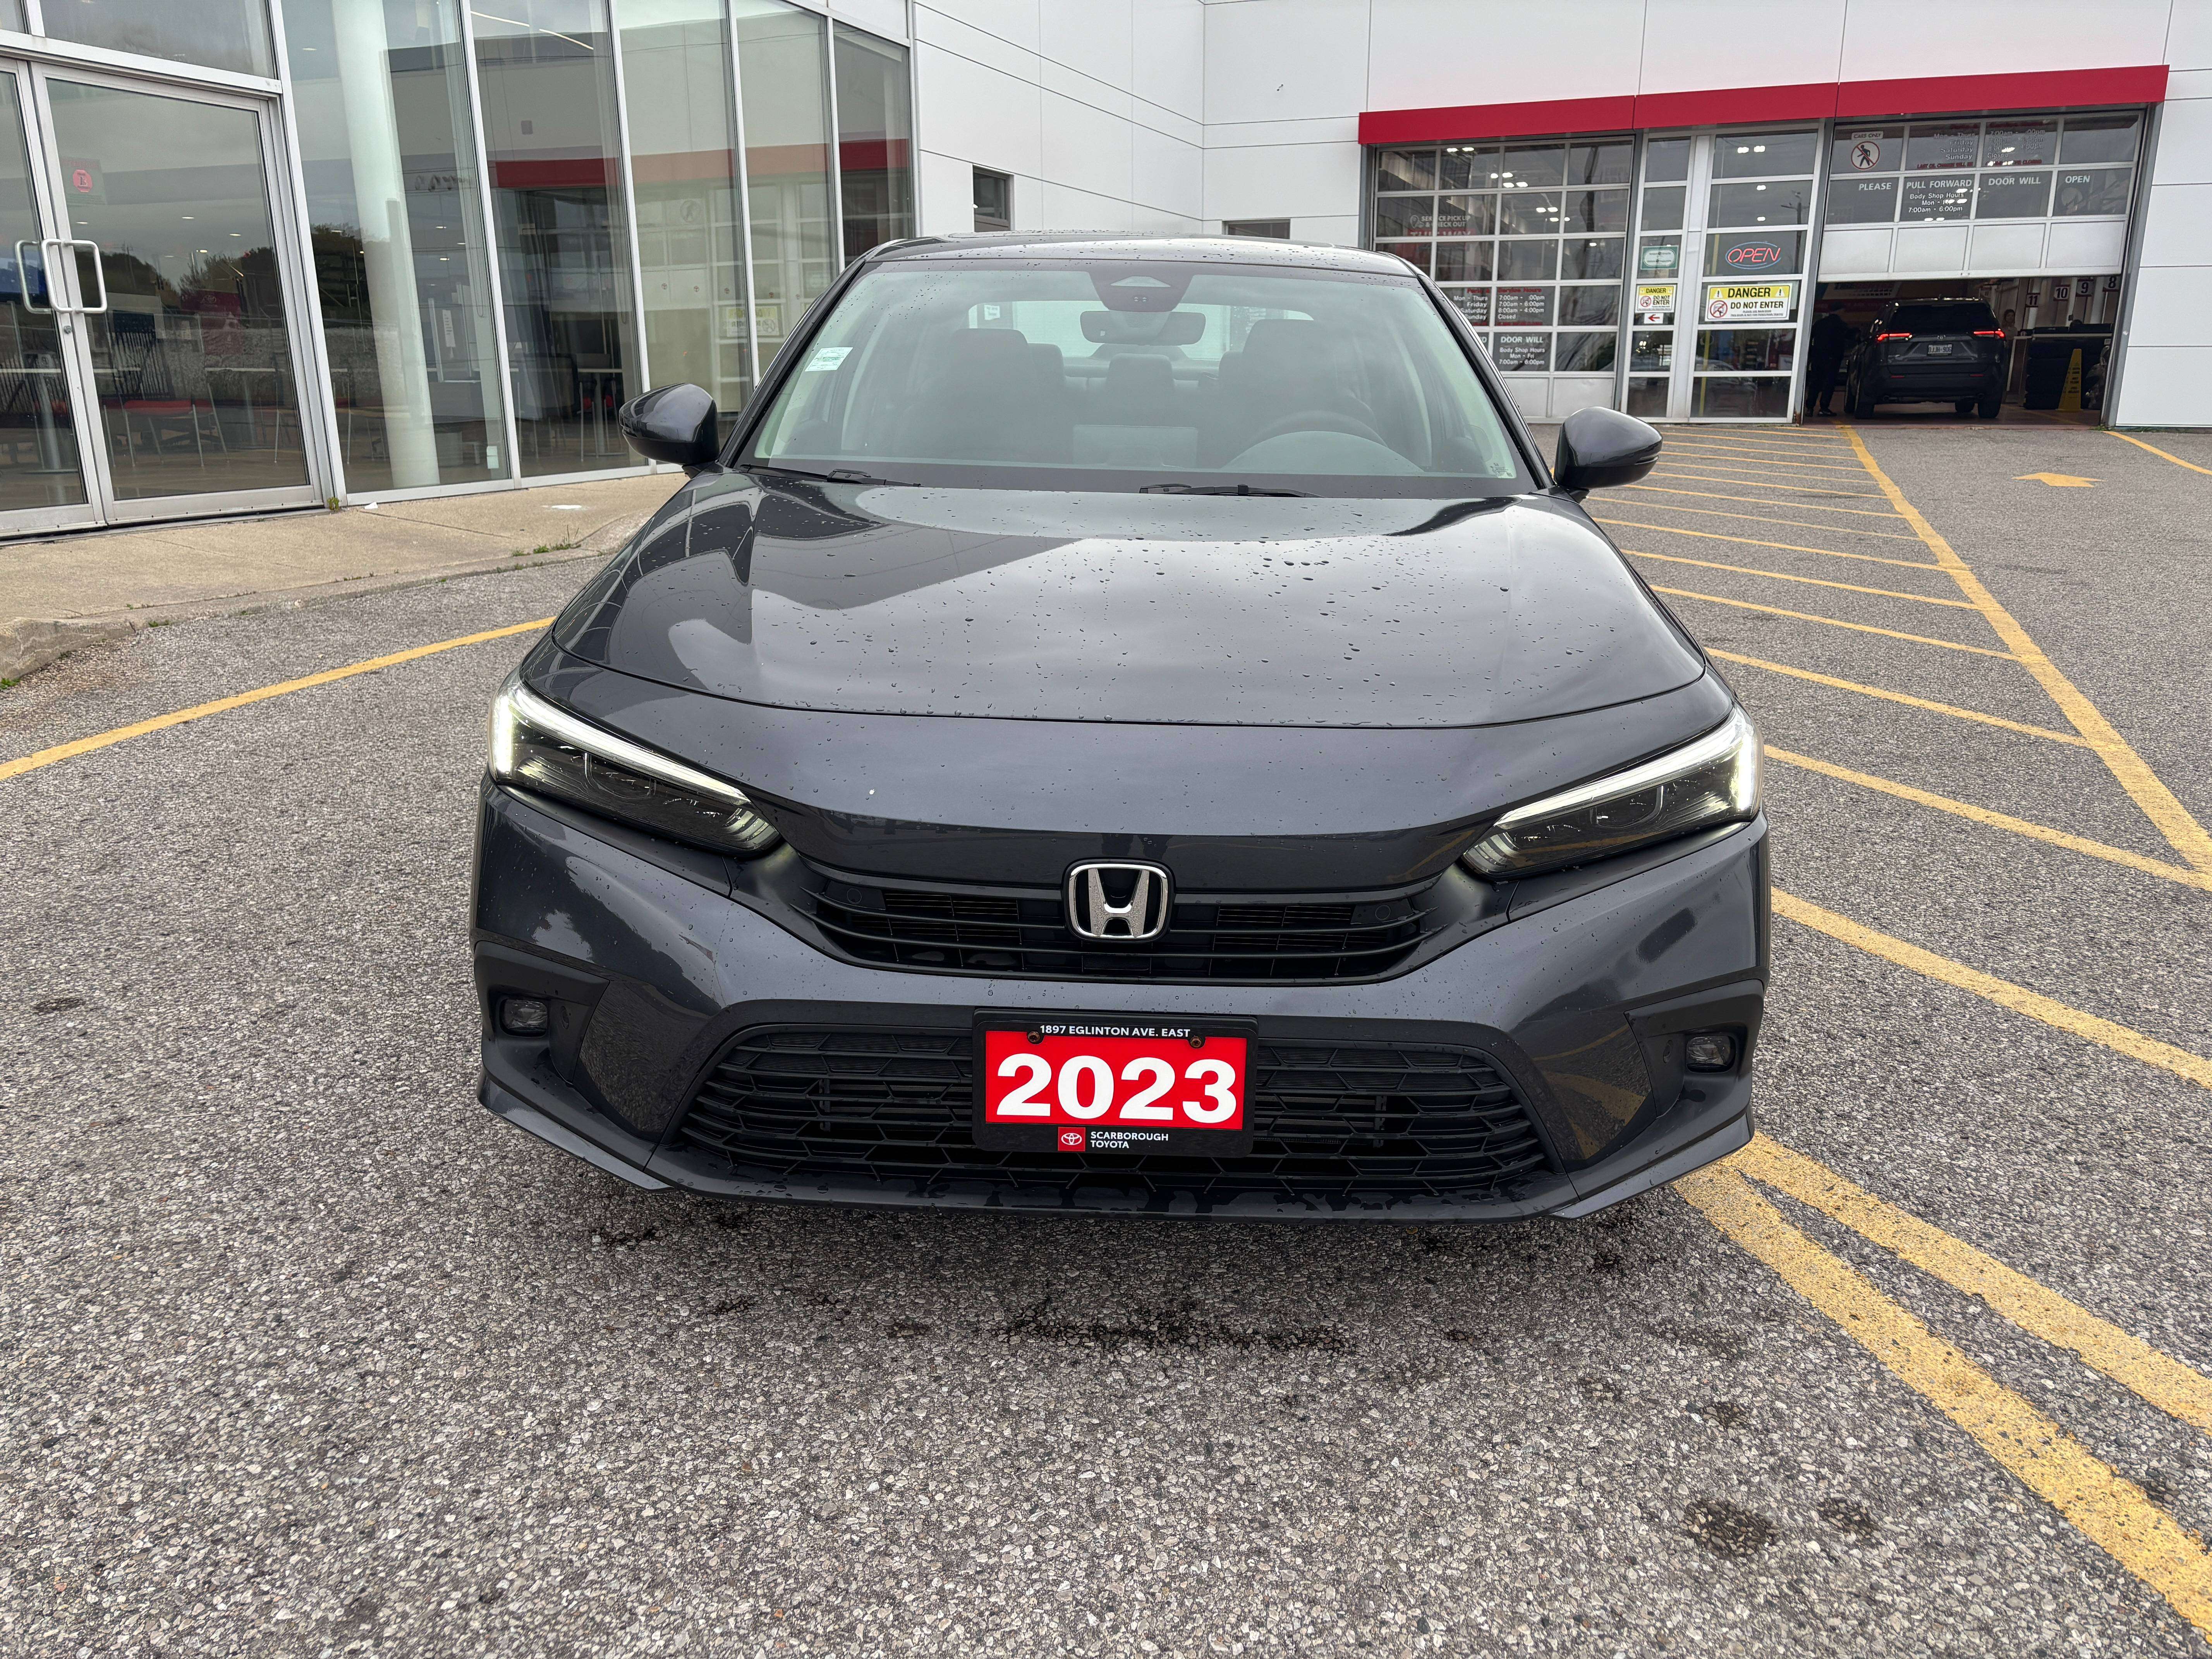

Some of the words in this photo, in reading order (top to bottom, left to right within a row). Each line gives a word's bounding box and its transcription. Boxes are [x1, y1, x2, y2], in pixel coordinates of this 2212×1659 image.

[1906, 181, 1926, 189] PULL
[1930, 180, 1972, 188] FORWARD
[2065, 175, 2090, 183] OPEN
[1728, 248, 1781, 263] OPEN
[2081, 282, 2089, 294] 9
[2109, 276, 2116, 288] 8
[1728, 287, 1771, 298] DANGER
[2056, 287, 2068, 299] 10
[2029, 295, 2038, 305] 11
[1039, 1025, 1066, 1034] 1897
[1069, 1026, 1129, 1036] EGLINTON
[1132, 1027, 1158, 1037] AVE.
[1161, 1029, 1190, 1037] EAST
[996, 1053, 1237, 1123] 2023
[1091, 1131, 1168, 1141] SCARBOROUGH
[1091, 1140, 1129, 1149] TOYOTA
